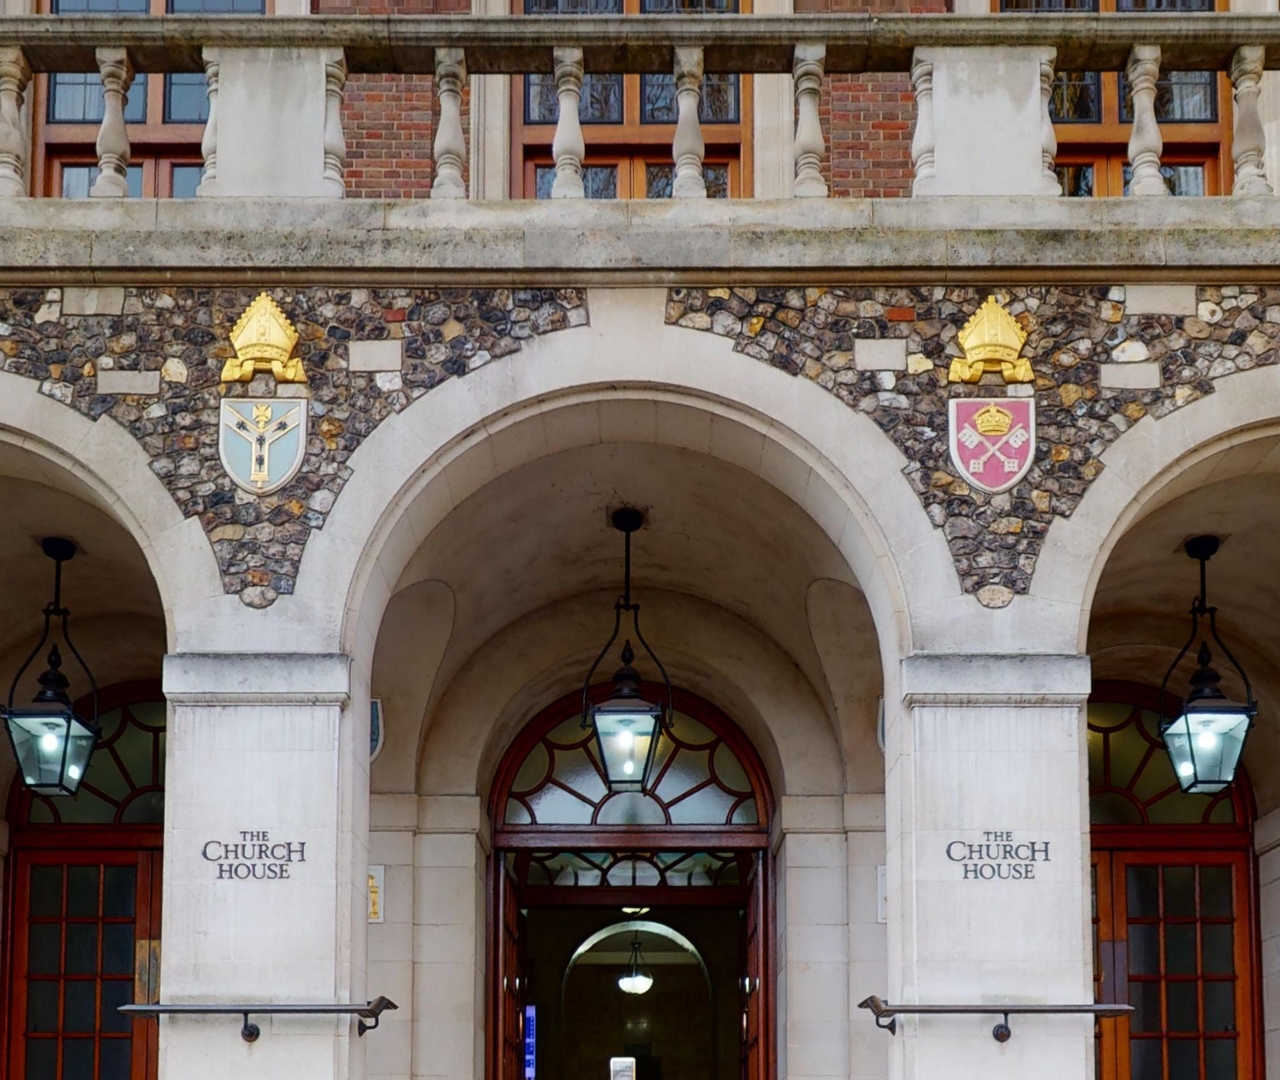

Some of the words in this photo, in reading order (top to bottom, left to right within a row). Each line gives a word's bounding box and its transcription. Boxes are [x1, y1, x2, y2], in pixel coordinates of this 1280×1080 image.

[240, 831, 269, 841] THE
[983, 831, 1013, 841] THE
[202, 840, 306, 862] CHURCH
[946, 840, 1051, 862] CHURCH
[217, 863, 290, 879] HOUSE
[962, 863, 1035, 879] HOUSE
